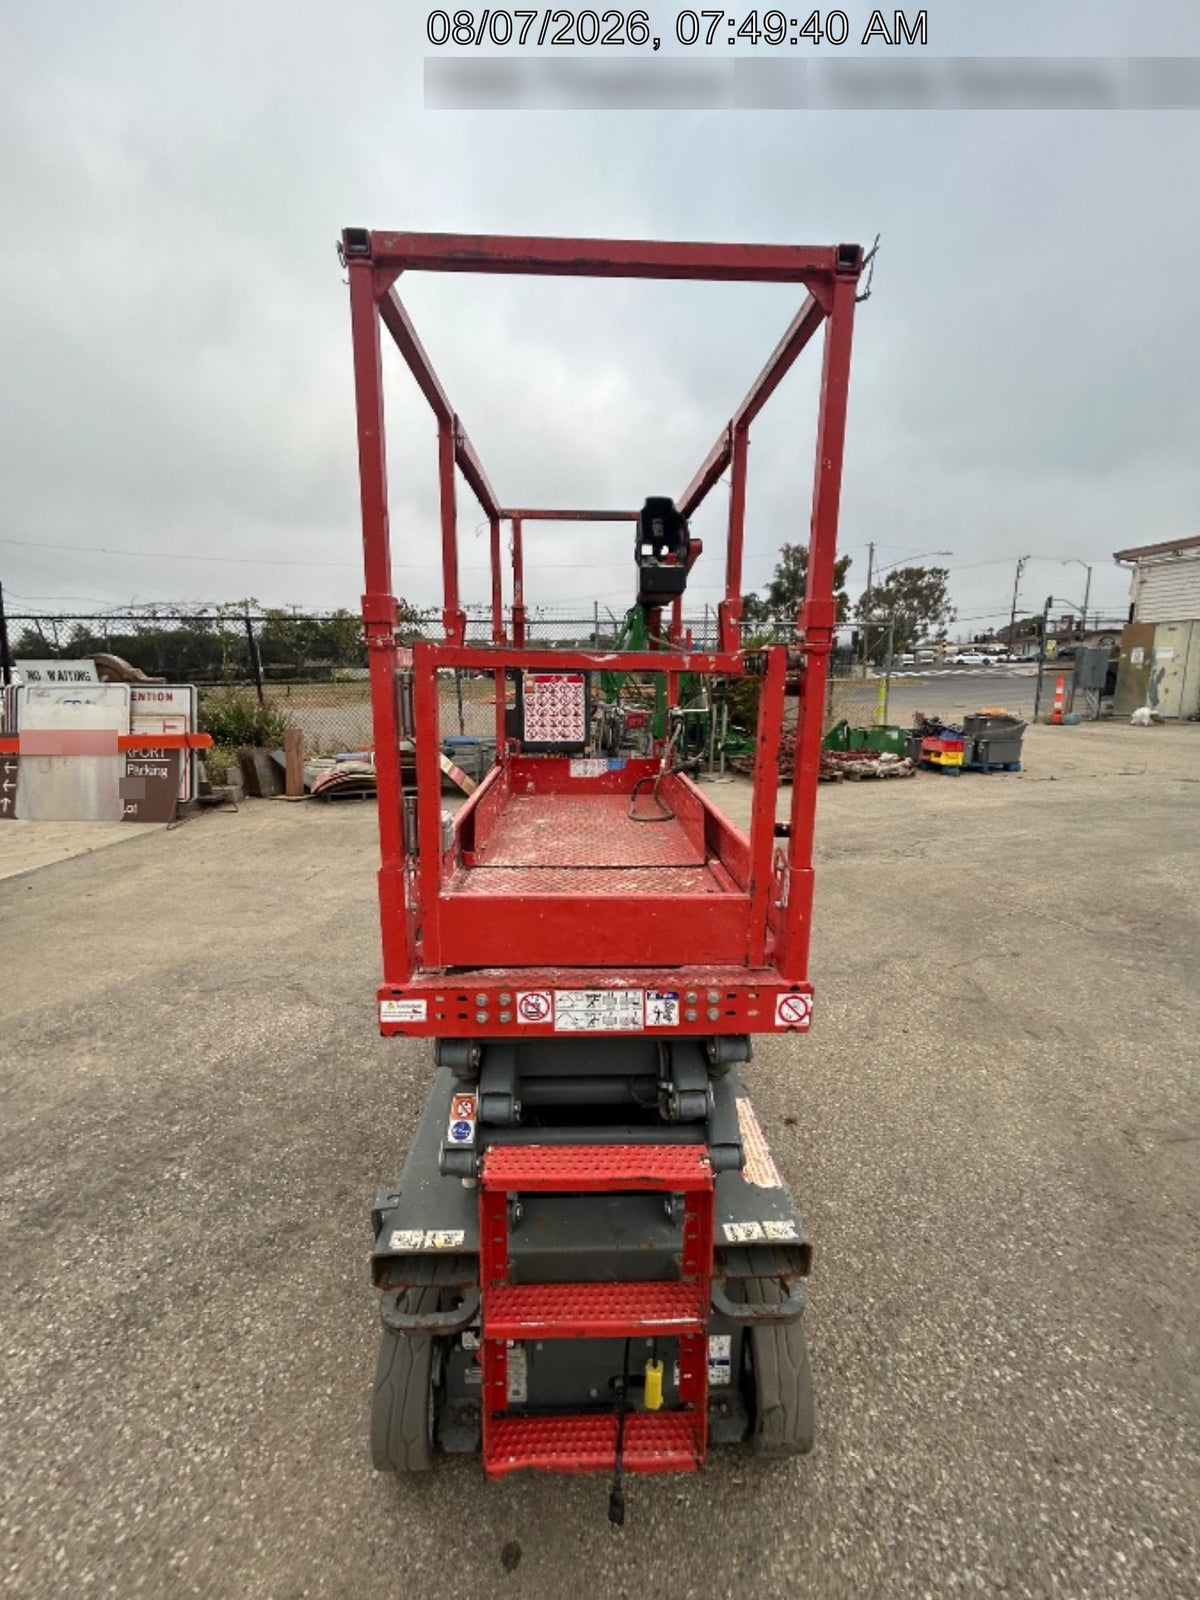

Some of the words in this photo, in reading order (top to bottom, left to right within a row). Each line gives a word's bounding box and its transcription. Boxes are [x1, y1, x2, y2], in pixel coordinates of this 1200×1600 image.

[26, 669, 41, 681] NO
[46, 669, 91, 682] WAITING
[127, 763, 168, 779] Parking
[123, 803, 138, 814] ot
